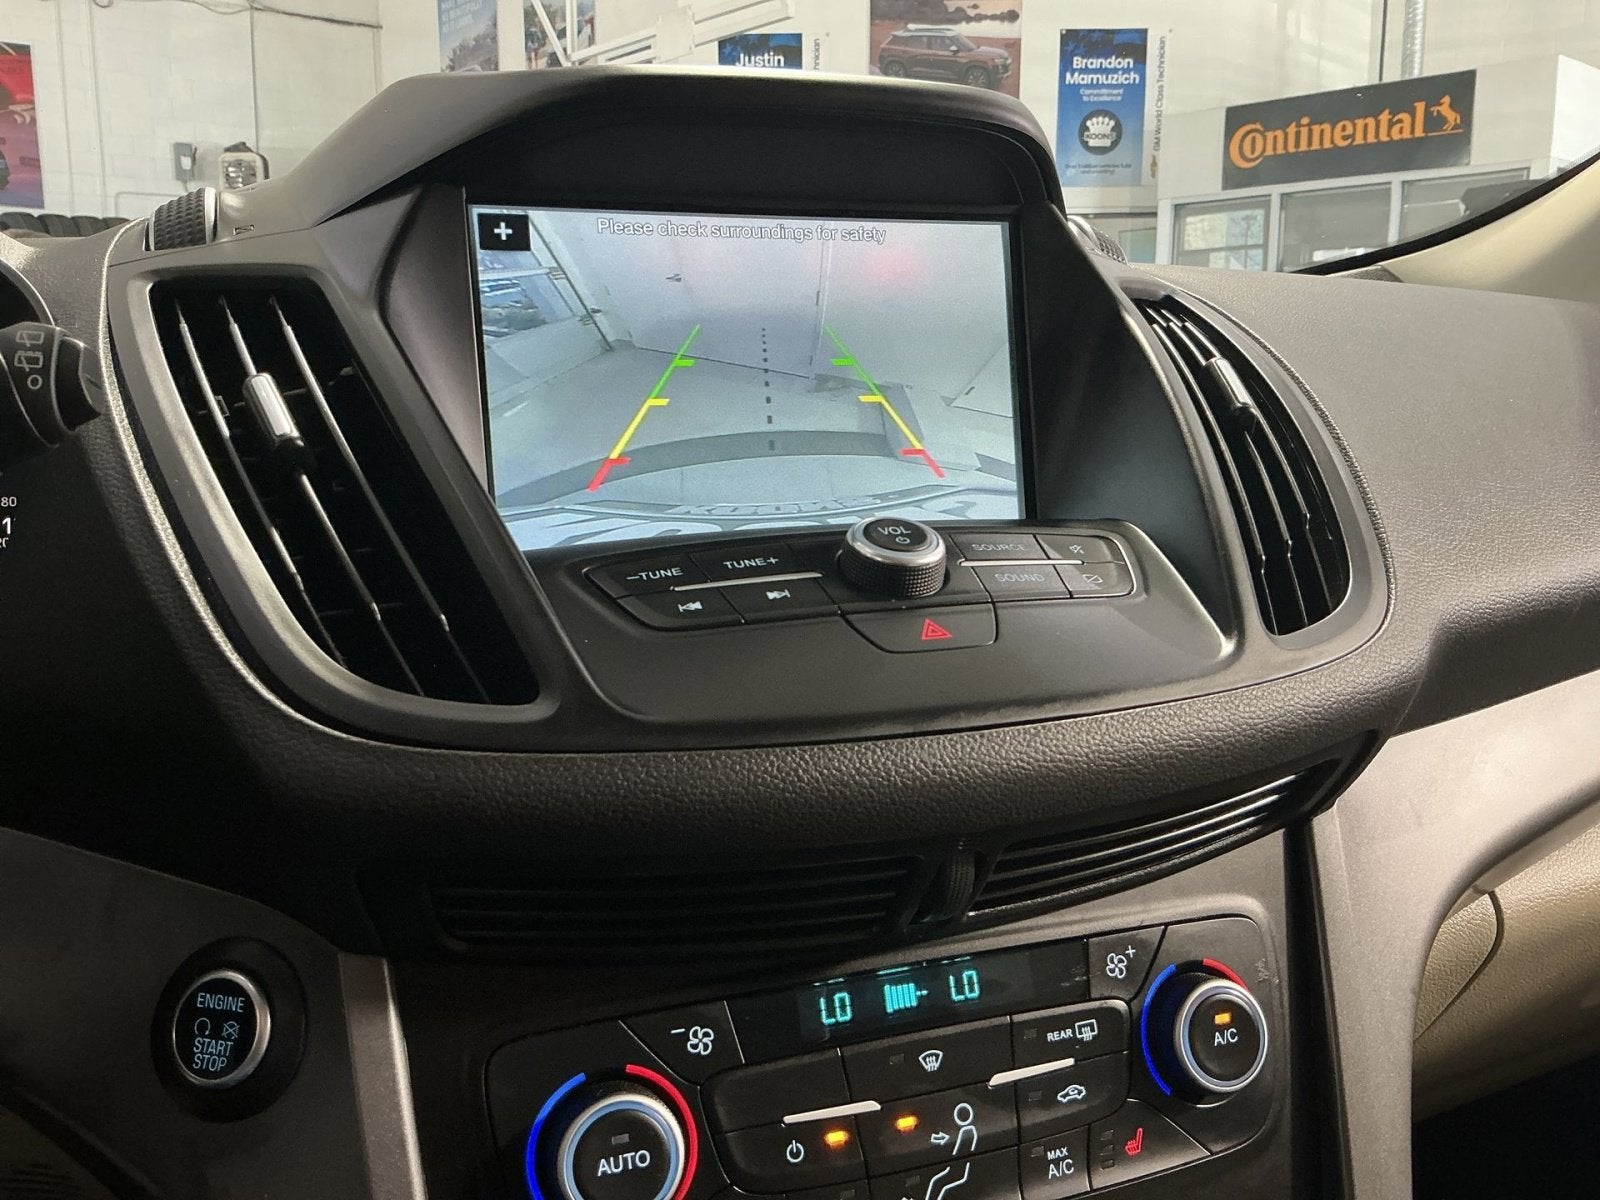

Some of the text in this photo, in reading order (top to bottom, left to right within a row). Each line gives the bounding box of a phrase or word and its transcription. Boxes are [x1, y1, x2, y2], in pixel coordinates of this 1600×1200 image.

[735, 51, 785, 67] Justin
[1072, 55, 1134, 70] Brandon
[1156, 36, 1165, 84] Technician
[1065, 71, 1140, 85] Mamuzich
[1229, 101, 1426, 169] Continental
[597, 218, 887, 245] Please check surroundings for safety
[877, 526, 912, 536] VOL
[971, 543, 1027, 552] SOURCE
[994, 573, 1046, 583] SOUND
[196, 992, 245, 1013] ENGINE
[1047, 1028, 1073, 1042] REAR
[1213, 1028, 1239, 1047] A/C
[193, 1037, 234, 1056] START
[192, 1053, 228, 1072] STOP
[1047, 1146, 1069, 1161] MAX
[597, 1150, 651, 1177] AUTO
[1048, 1158, 1075, 1180] A/C
